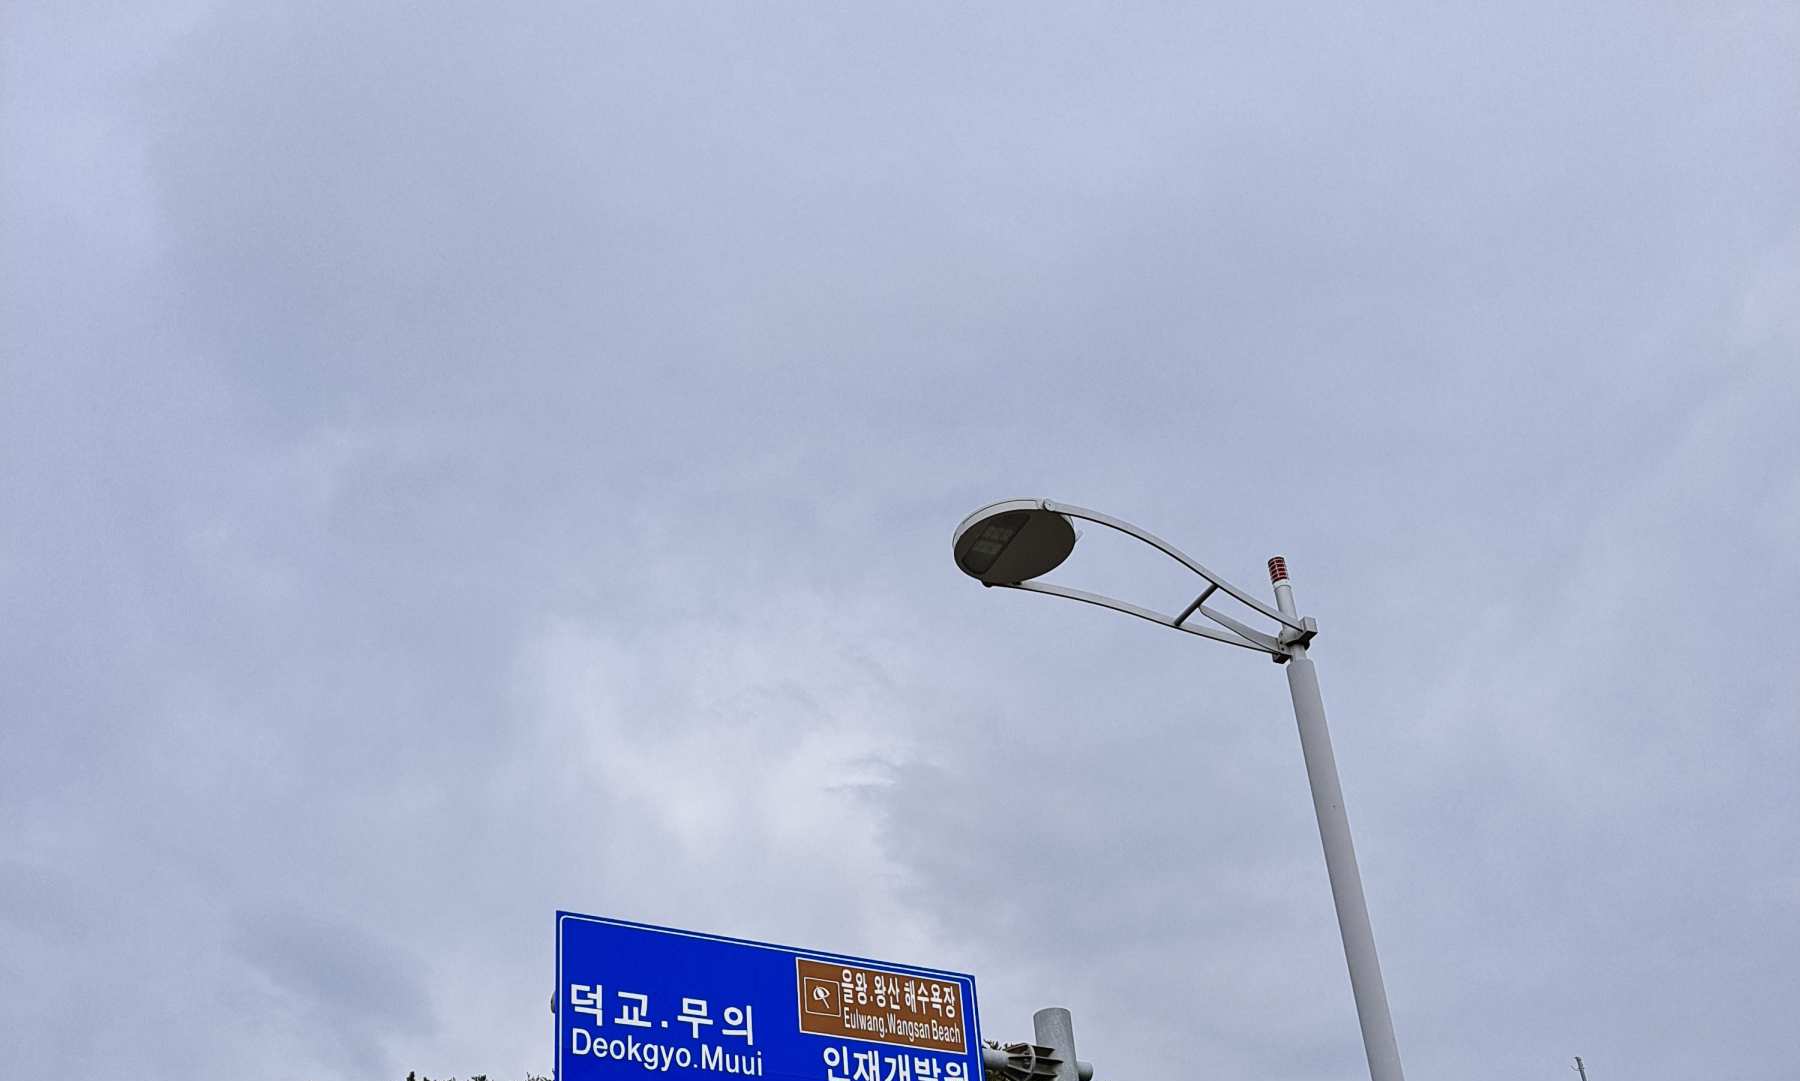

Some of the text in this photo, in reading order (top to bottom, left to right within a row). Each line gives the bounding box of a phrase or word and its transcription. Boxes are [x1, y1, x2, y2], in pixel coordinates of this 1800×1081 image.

[903, 979, 956, 1018] 해수욕장
[843, 1007, 961, 1044] Eulwang.Wangsan Beach
[572, 1027, 763, 1076] Deokgyo.Muui
